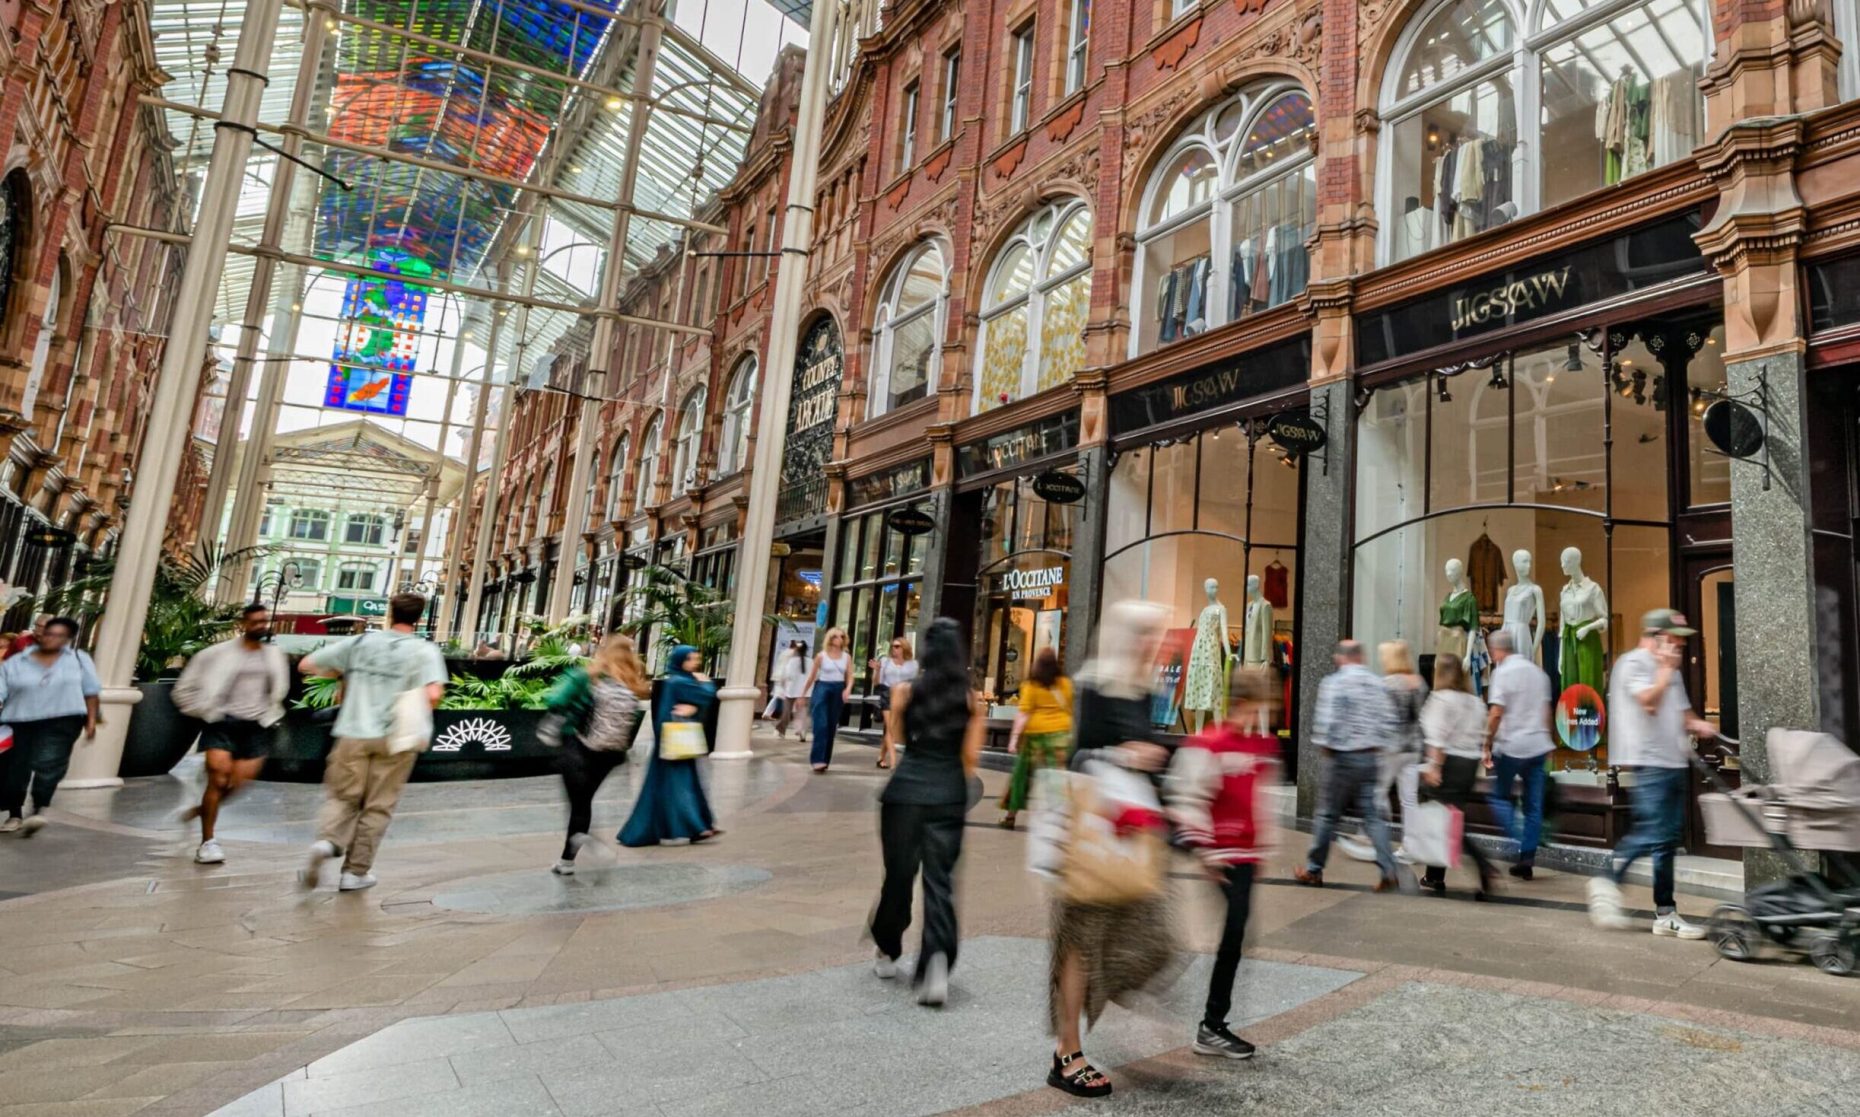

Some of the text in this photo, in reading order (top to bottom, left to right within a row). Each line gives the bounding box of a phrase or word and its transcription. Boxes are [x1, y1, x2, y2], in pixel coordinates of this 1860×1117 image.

[1452, 265, 1572, 332] JIGSAW
[795, 387, 836, 433] ARCADE
[1002, 567, 1063, 591] L'OCCITANE
[1573, 707, 1587, 715] New
[1579, 717, 1599, 726] Added
